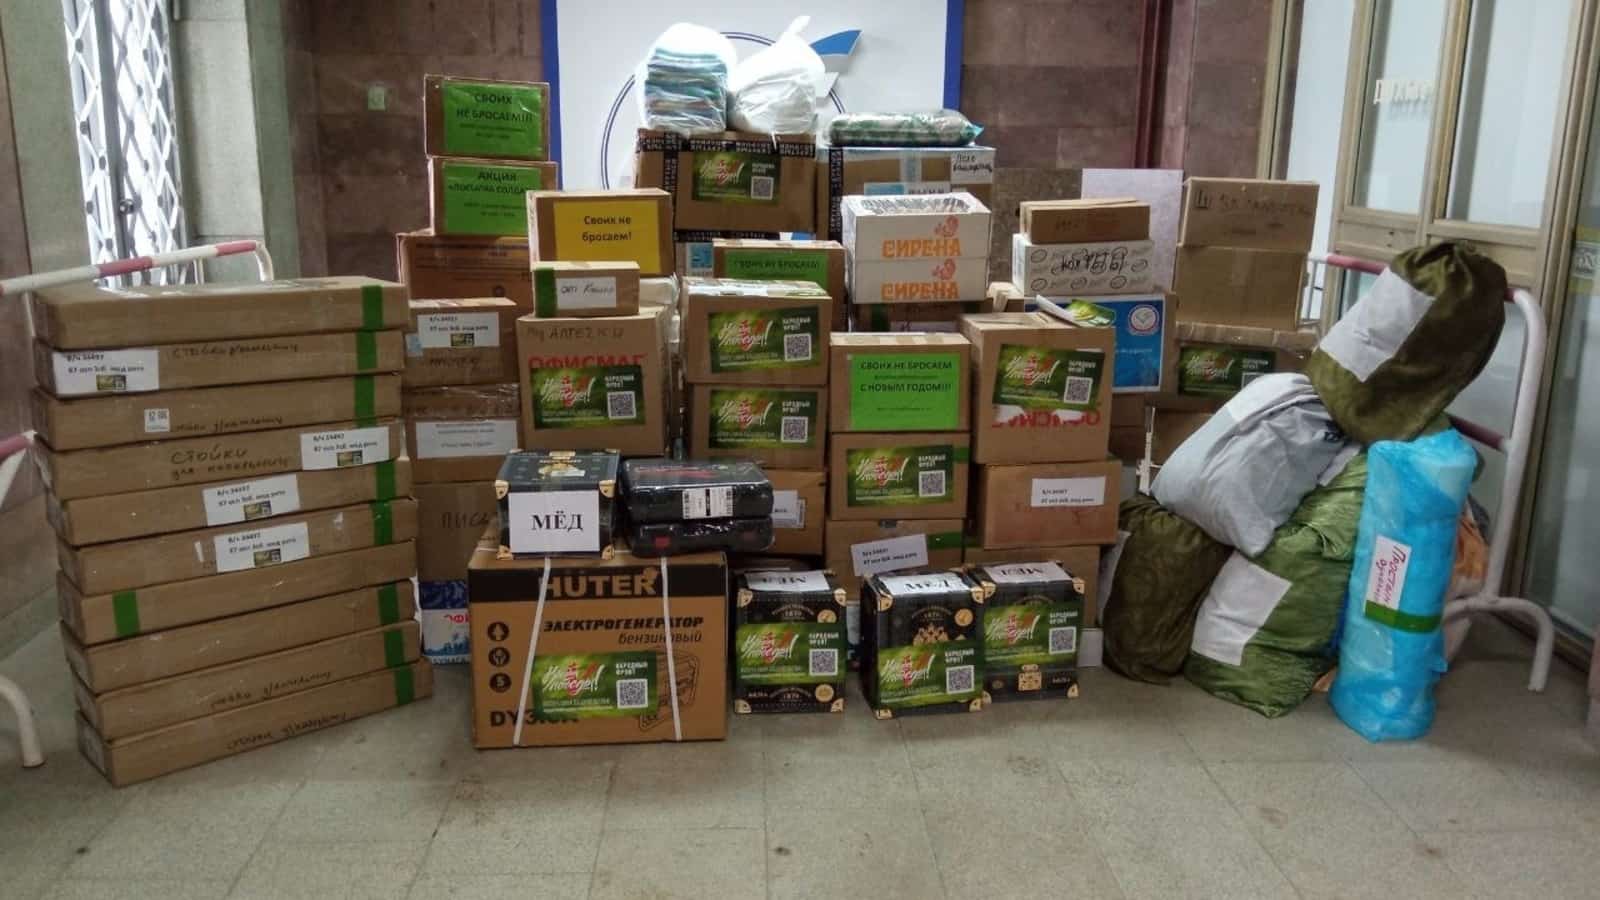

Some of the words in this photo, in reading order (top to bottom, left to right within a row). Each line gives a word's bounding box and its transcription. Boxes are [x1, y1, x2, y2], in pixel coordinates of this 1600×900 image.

[474, 94, 512, 104] СВОИХ
[478, 171, 516, 182] АКЦИЯ
[584, 216, 615, 226] Своих
[619, 217, 631, 226] не
[582, 232, 632, 242] бросаем!
[882, 239, 962, 257] СИРЕНА
[881, 282, 959, 298] СИРЕНА
[861, 360, 892, 369] СВОИХ
[908, 361, 952, 369] БРОСАЕМ
[869, 383, 904, 392] НОВЫМ
[532, 510, 583, 531] МЁД
